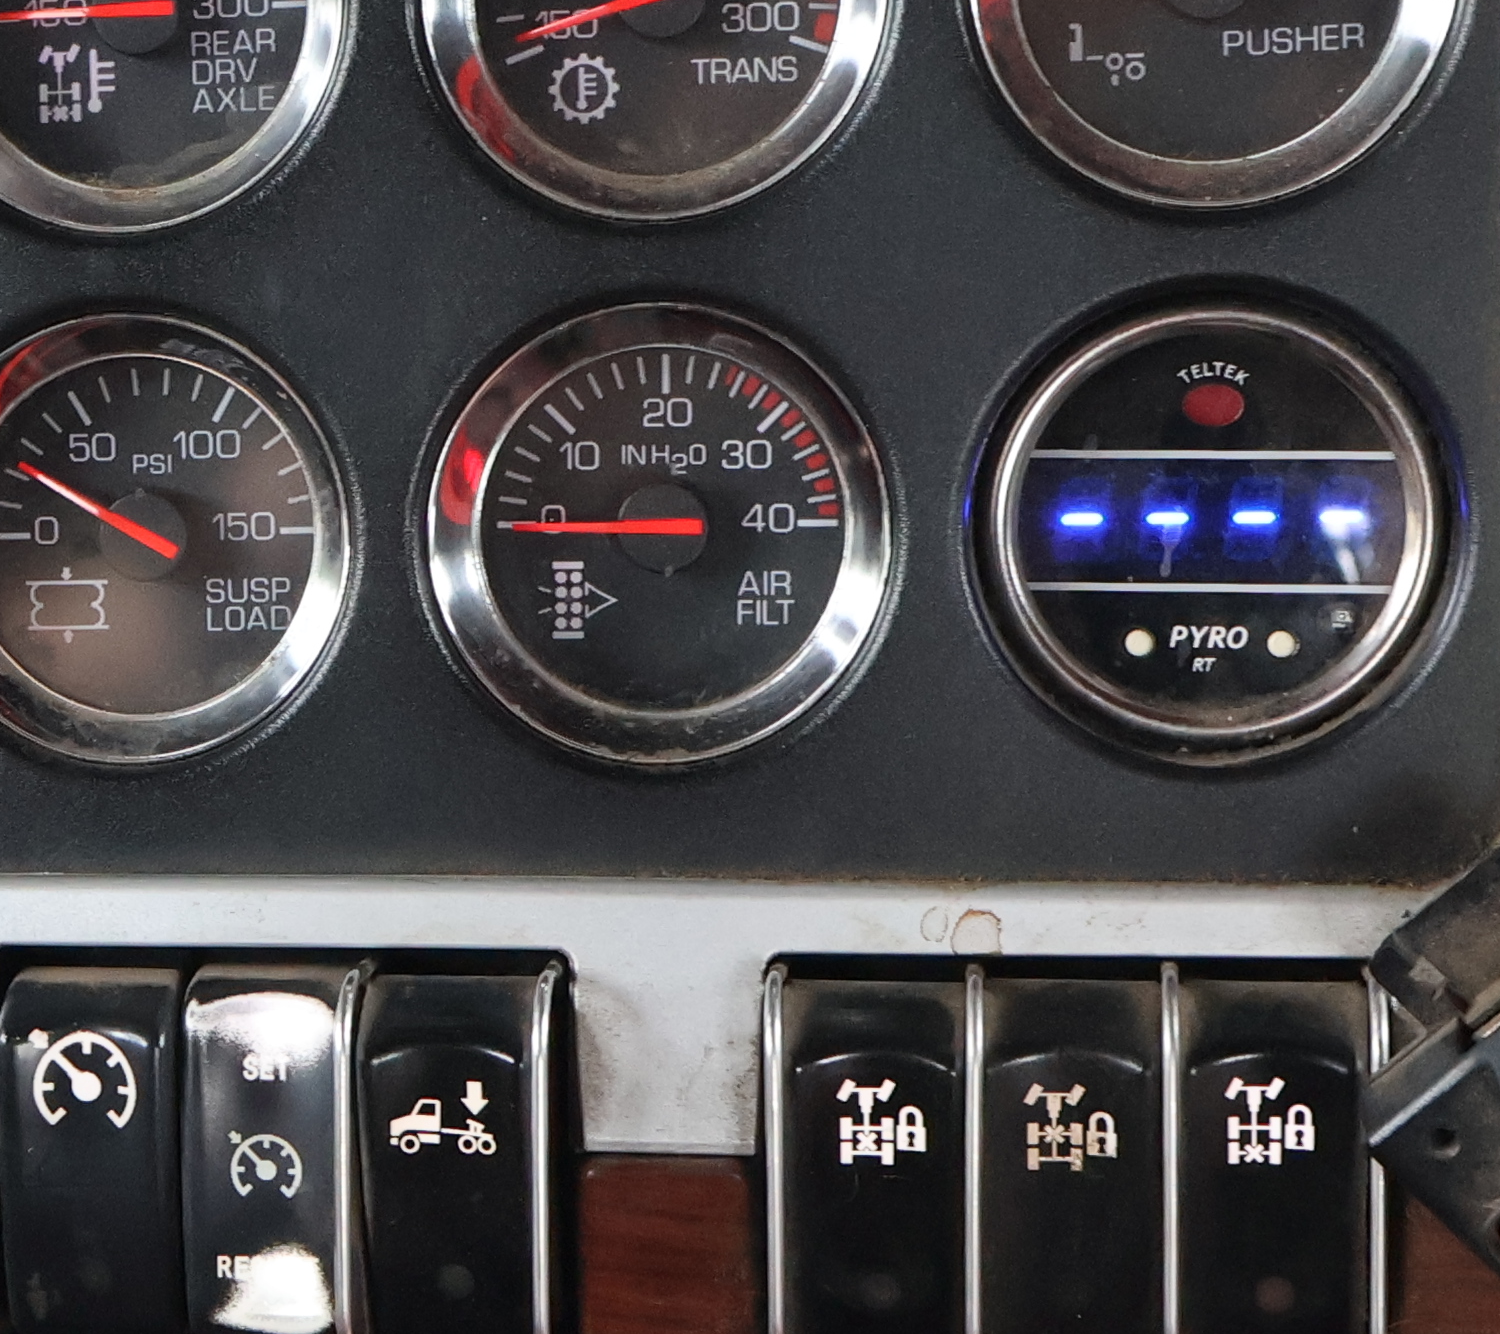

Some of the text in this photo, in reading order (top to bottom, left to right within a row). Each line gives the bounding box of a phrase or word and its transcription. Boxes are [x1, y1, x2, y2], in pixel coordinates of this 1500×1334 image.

[721, 1, 800, 34] 300
[191, 29, 276, 56] REAR
[1222, 22, 1365, 57] PUSHER
[191, 58, 258, 86] DRV
[690, 56, 798, 85] TRANS
[192, 86, 276, 114] AXLE
[1176, 362, 1251, 386] TELTEK
[642, 397, 693, 427] 20
[68, 432, 117, 463] 50
[172, 429, 241, 460] 100
[559, 440, 600, 471] 10
[721, 439, 773, 470] 30
[132, 453, 173, 475] PSI
[33, 514, 60, 546] 0
[211, 511, 276, 542] 150
[741, 502, 796, 534] 40
[205, 577, 291, 604] SUSP
[737, 569, 793, 596] AIR
[206, 604, 292, 633] LOAD
[737, 599, 795, 626] FILT
[1169, 625, 1249, 650] PYRO
